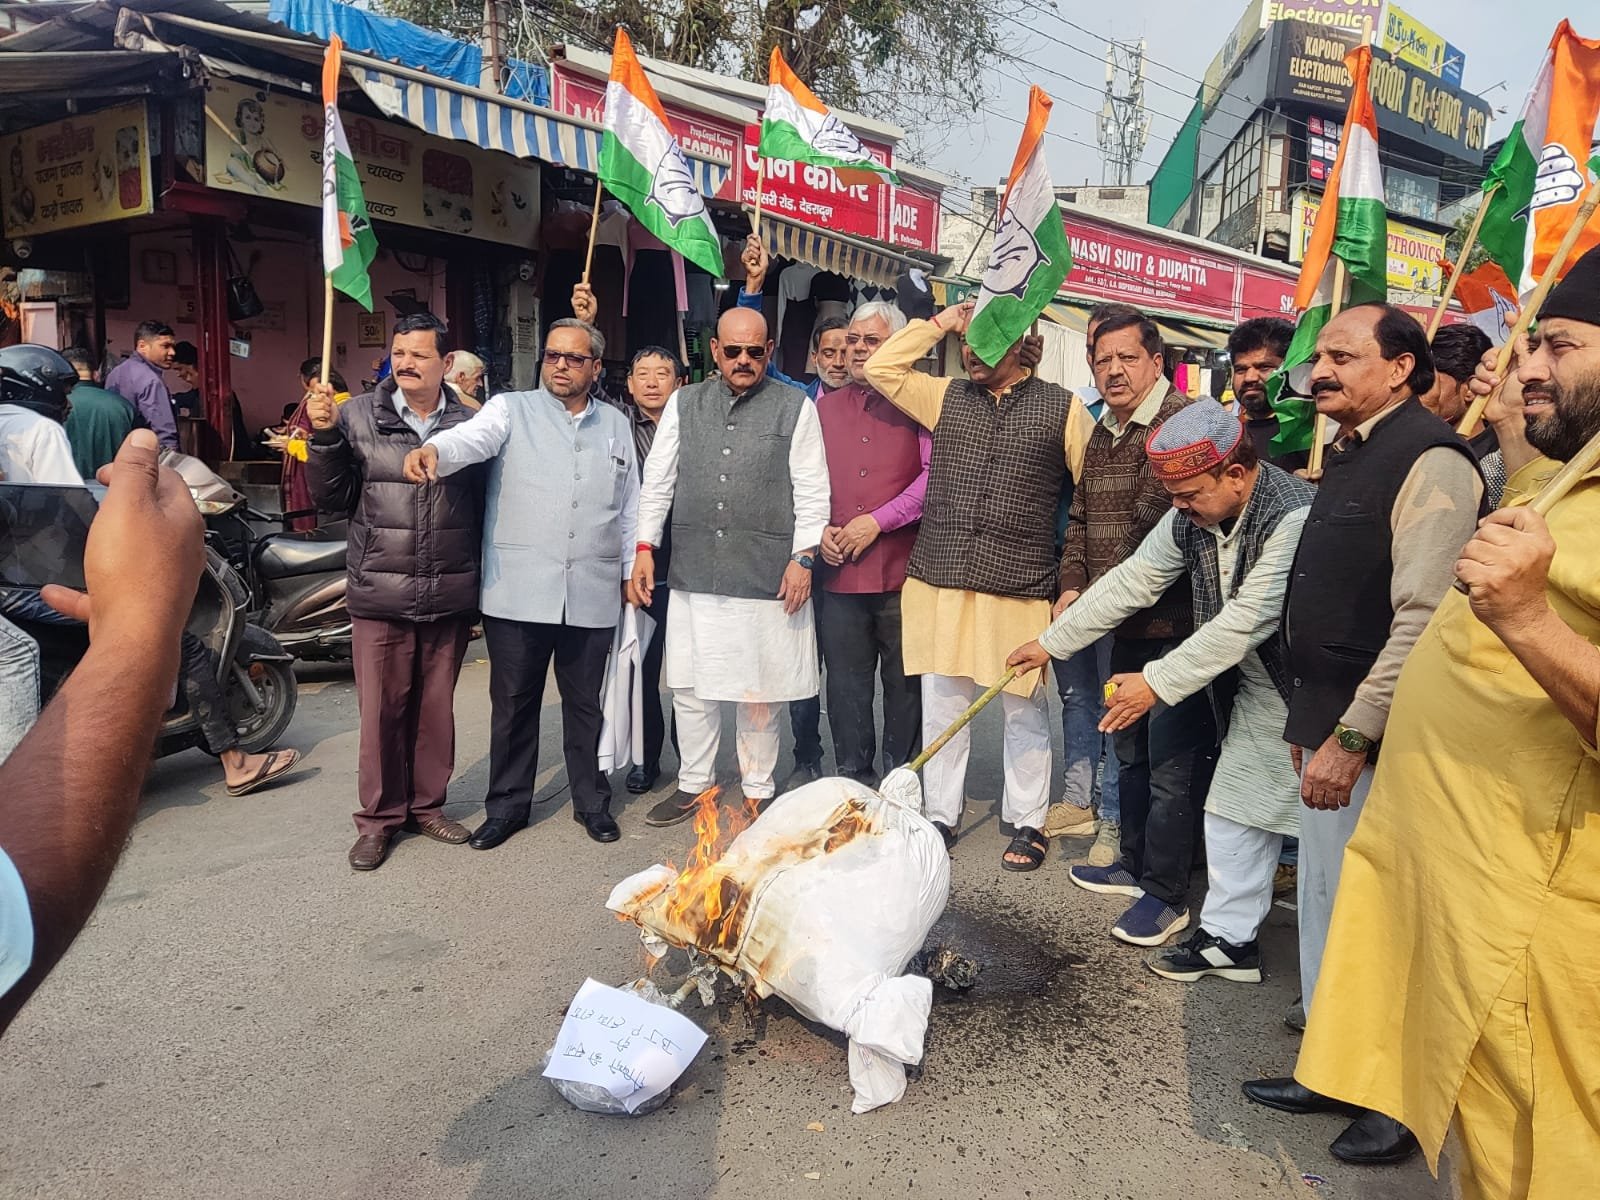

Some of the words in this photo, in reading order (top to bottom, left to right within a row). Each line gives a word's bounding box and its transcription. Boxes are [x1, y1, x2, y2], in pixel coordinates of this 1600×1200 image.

[1304, 36, 1345, 62] KAPOOR
[1289, 57, 1353, 87] ELECTRONICS
[1369, 57, 1406, 113] POOR
[366, 163, 406, 183] चावल
[364, 200, 398, 217] ावल
[1067, 236, 1111, 266] NASVI
[1114, 248, 1143, 273] SUIT
[1146, 255, 1155, 276] &
[1159, 258, 1207, 287] DUPATTA
